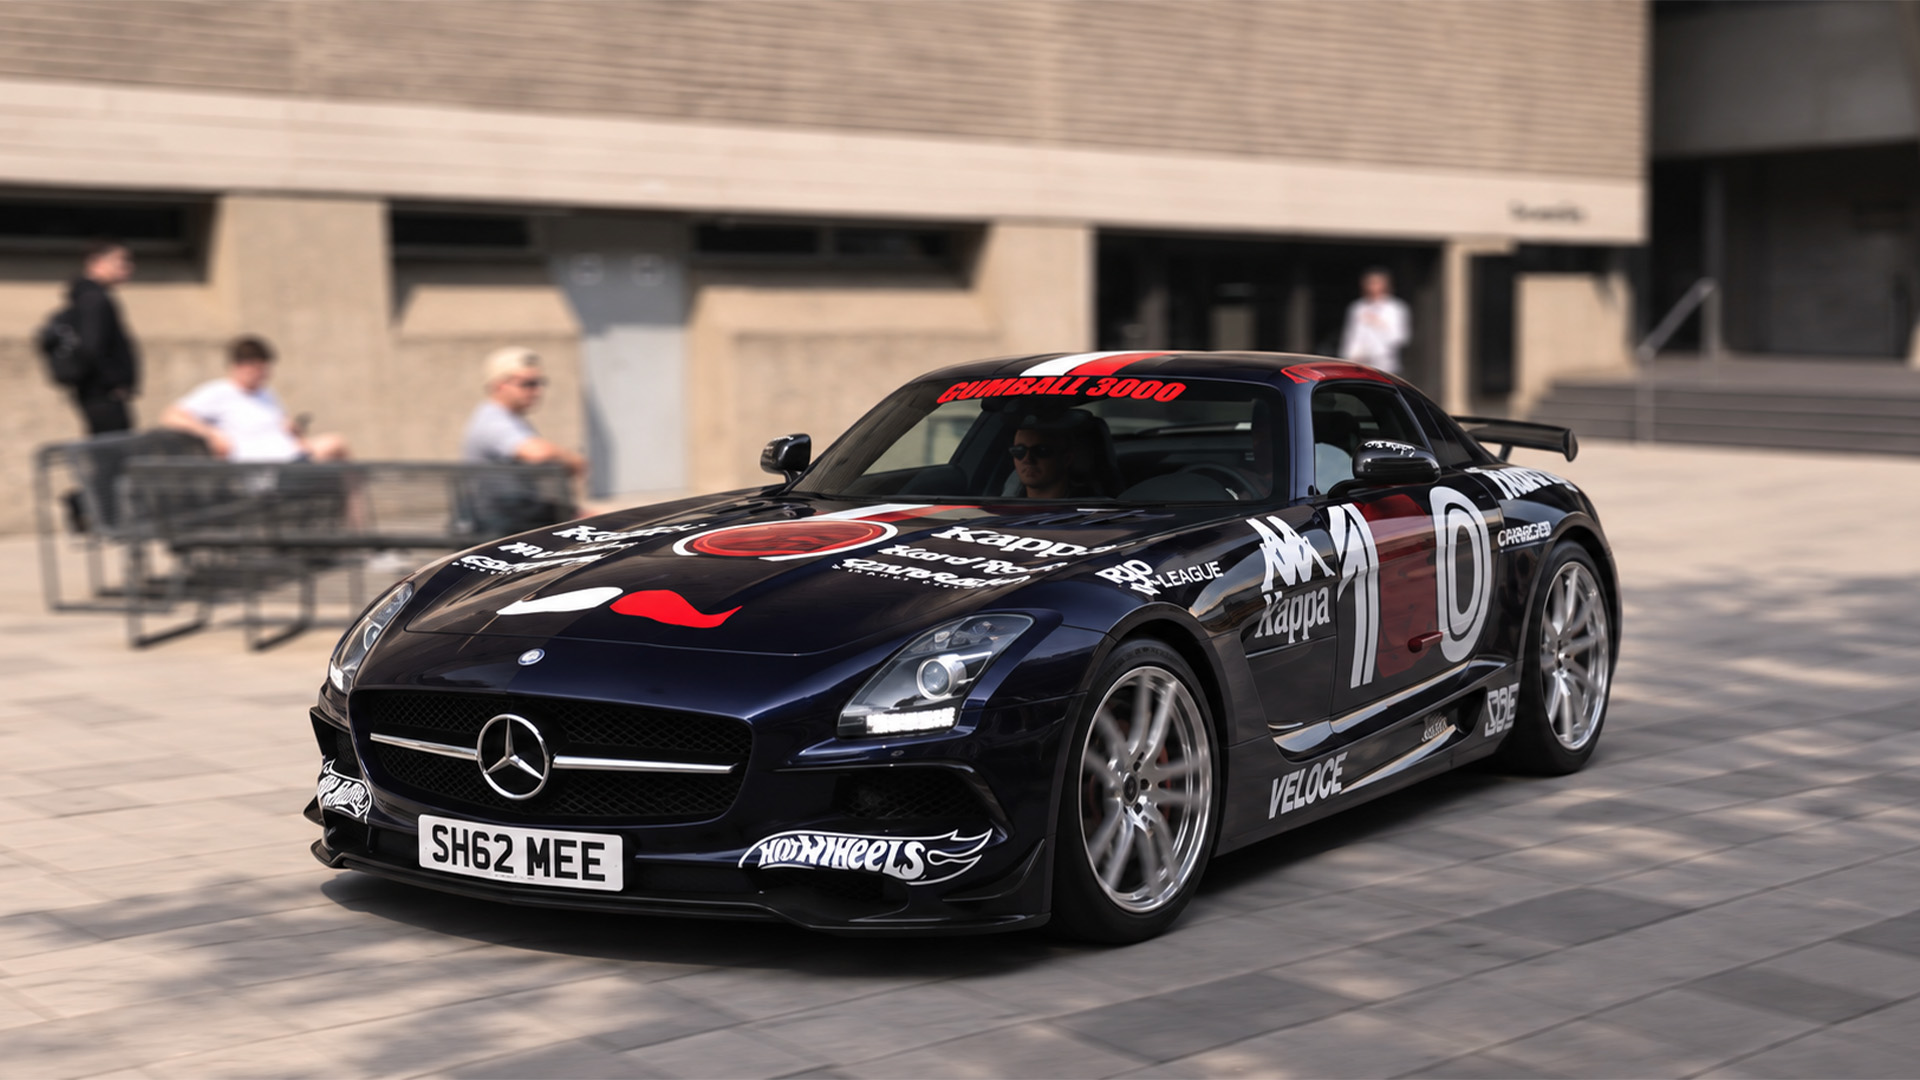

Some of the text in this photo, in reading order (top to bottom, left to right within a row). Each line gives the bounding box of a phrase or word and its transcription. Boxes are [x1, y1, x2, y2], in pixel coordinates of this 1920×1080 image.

[937, 377, 1187, 404] GUMBALL 3000
[1155, 561, 1224, 588] LEAGUE
[1254, 586, 1330, 644] Kappa
[1268, 752, 1348, 819] VELOCE
[432, 824, 605, 882] SH62 MEE
